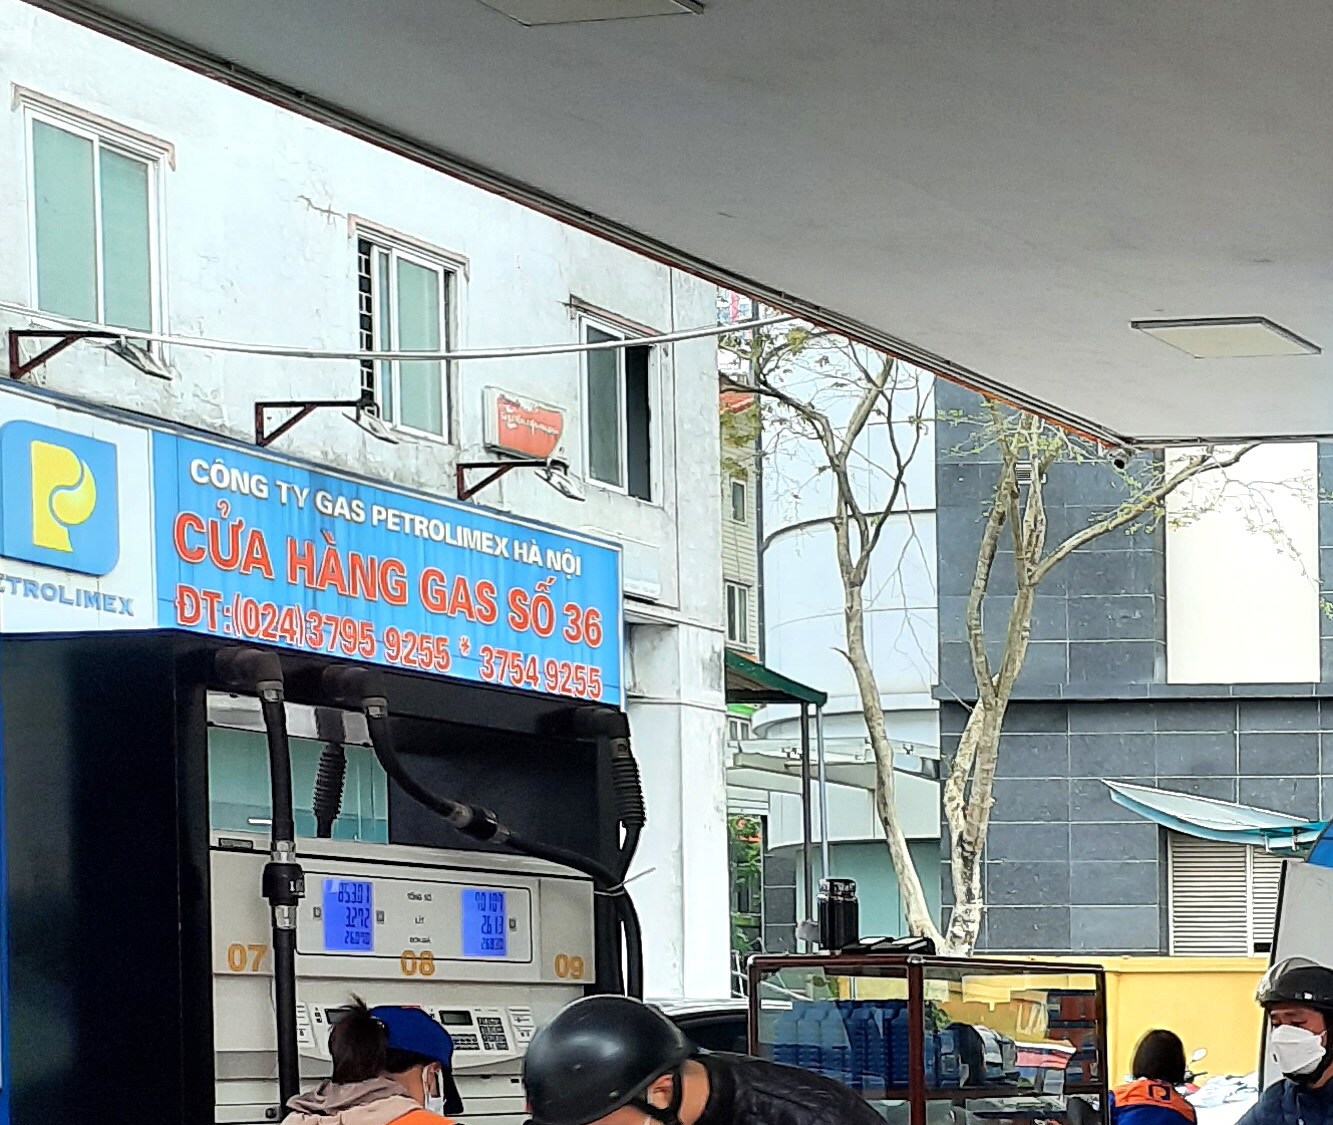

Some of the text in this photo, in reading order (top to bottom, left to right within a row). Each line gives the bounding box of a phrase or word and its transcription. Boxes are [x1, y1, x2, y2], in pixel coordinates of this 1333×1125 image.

[189, 457, 582, 578] CÔNG TY GAS PETROLIMEX HÀ NỘI
[174, 499, 604, 649] CỬA HÀNG GAS SỐ 36
[383, 626, 451, 673] 9255
[479, 644, 540, 690] 3754
[543, 660, 604, 702] 9255
[227, 943, 268, 972] 07
[400, 949, 436, 977] 08
[554, 954, 585, 979] 09
